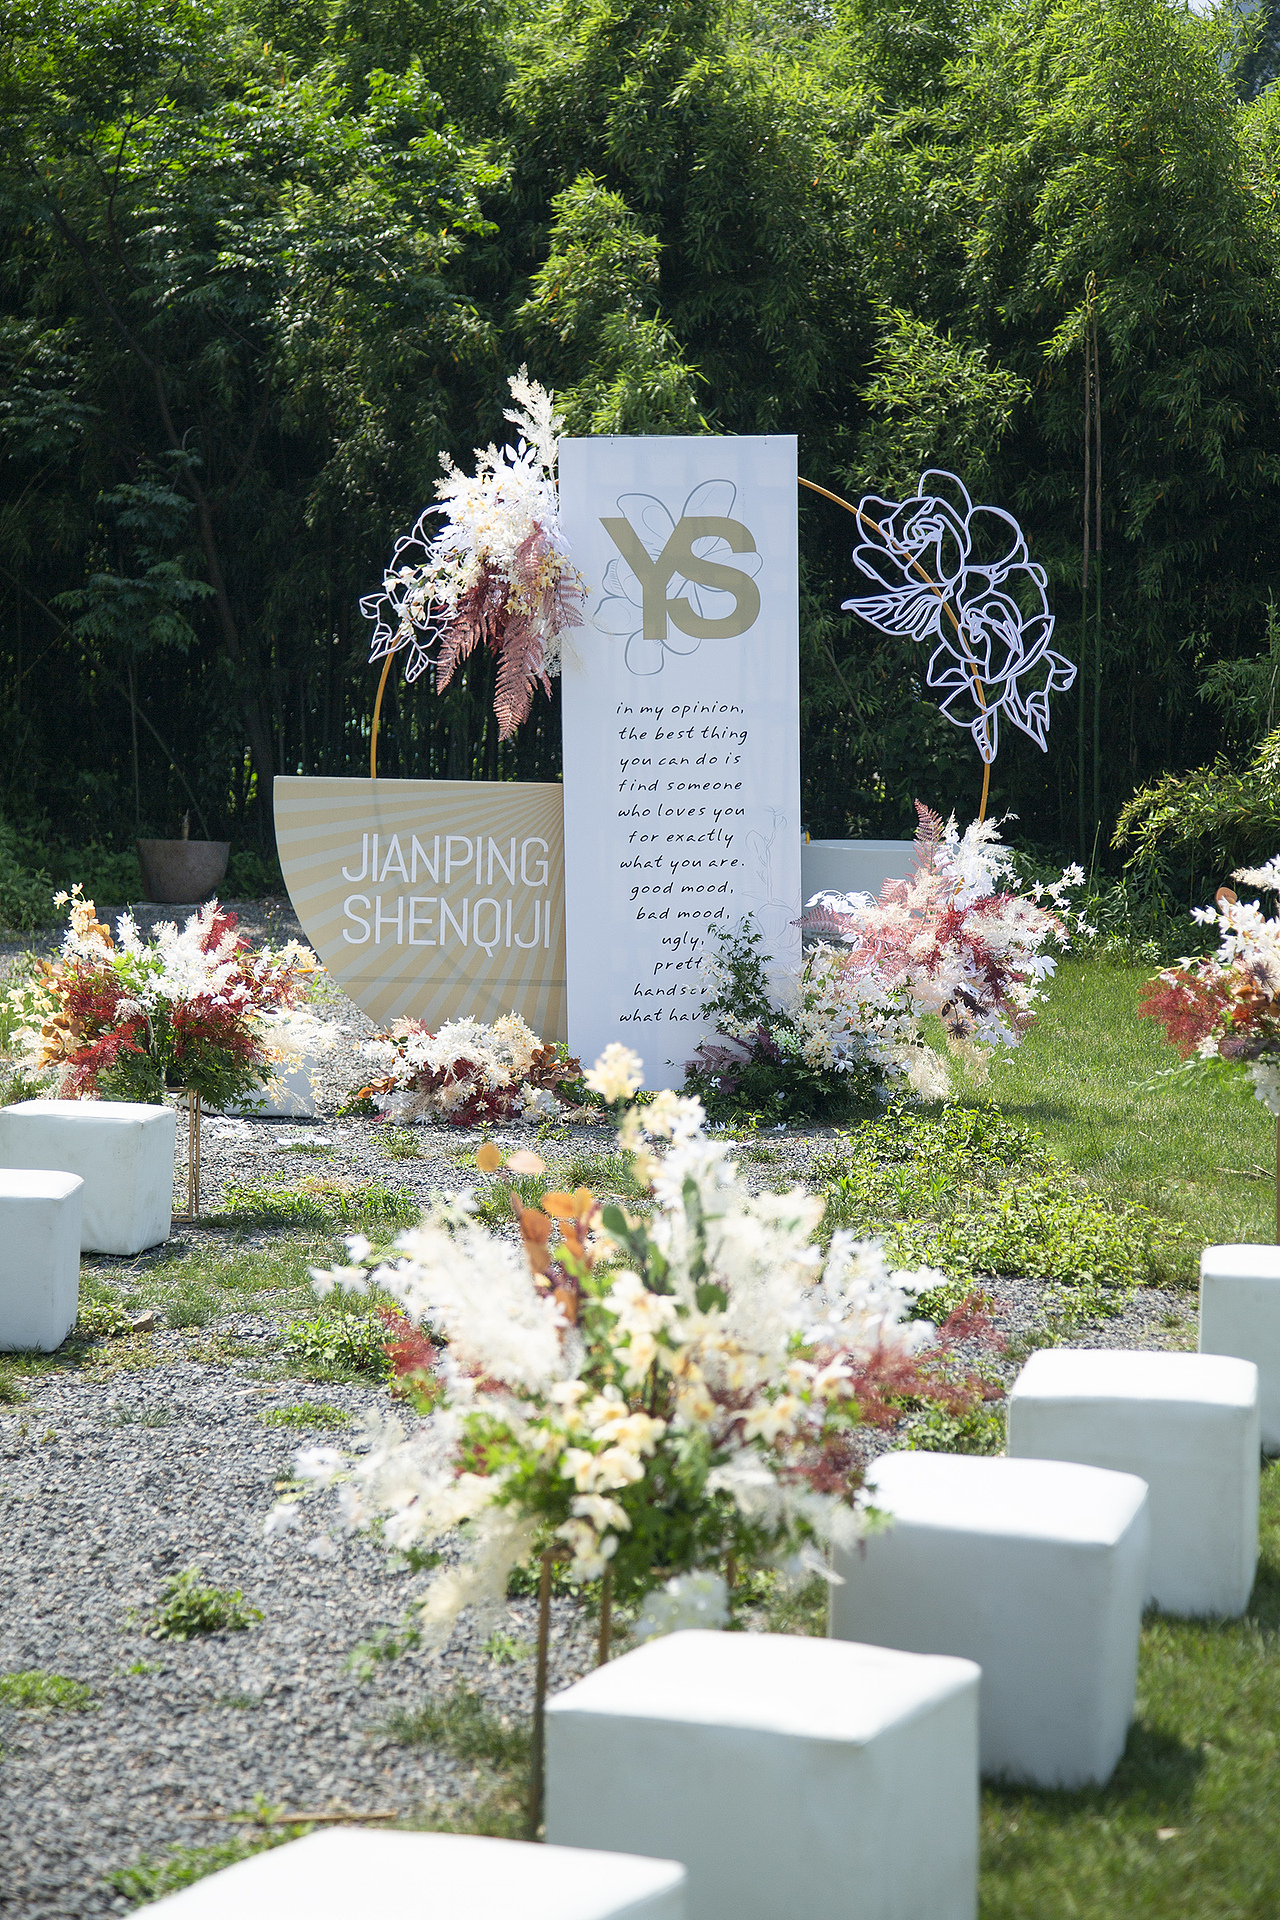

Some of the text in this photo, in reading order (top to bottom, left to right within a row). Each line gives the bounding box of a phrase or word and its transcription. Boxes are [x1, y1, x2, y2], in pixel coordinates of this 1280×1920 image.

[597, 515, 760, 639] YS
[615, 700, 744, 720] in my opinion,
[617, 724, 747, 745] the best thing
[619, 751, 741, 772] you can do is
[617, 778, 742, 792] find someone
[617, 802, 744, 822] who loves you
[627, 827, 733, 848] for exactly
[340, 831, 548, 886] JIANPING
[618, 854, 745, 874] what you are.
[628, 880, 734, 900] good mood,
[635, 905, 730, 919] bad mood,
[341, 893, 550, 957] SHENQIJI
[660, 930, 704, 951] ugly,
[652, 955, 710, 975] prett
[618, 1007, 710, 1021] what have
